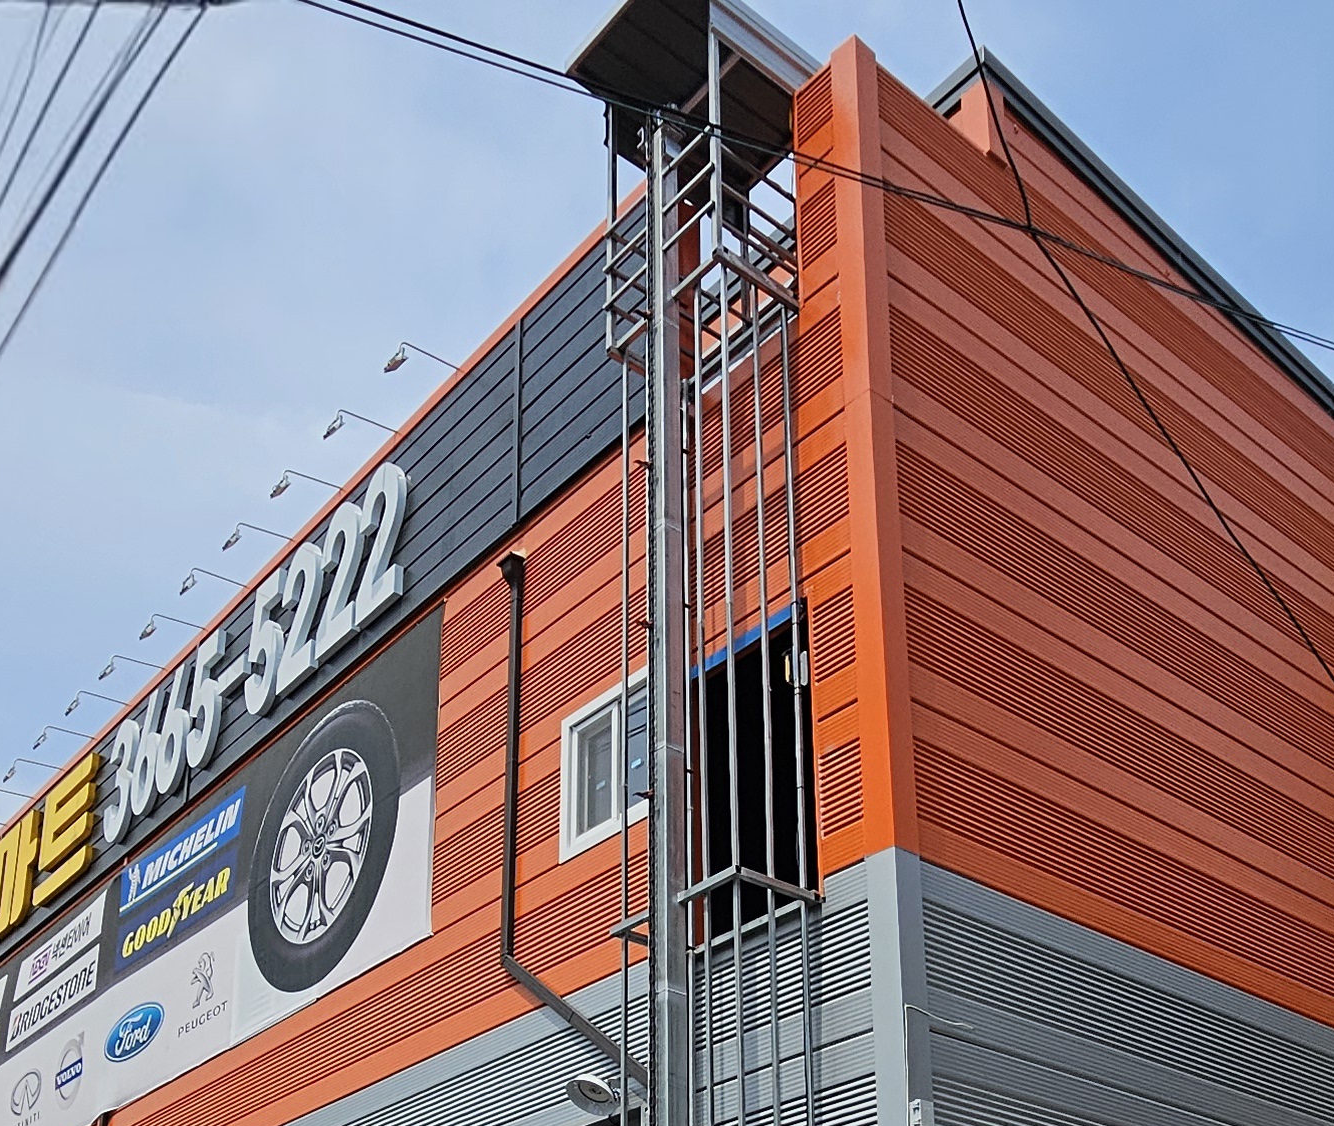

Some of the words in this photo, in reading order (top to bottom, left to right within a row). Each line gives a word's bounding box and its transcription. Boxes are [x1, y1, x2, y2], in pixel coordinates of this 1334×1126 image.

[103, 462, 407, 843] 3665-5222
[141, 798, 241, 889] MICHELIN
[121, 867, 231, 959] GOODYEAR
[10, 959, 97, 1043] BRIDGESTONE
[115, 1012, 152, 1056] Ford
[177, 1001, 229, 1038] PEUGEOT
[55, 1061, 83, 1086] VOLVO
